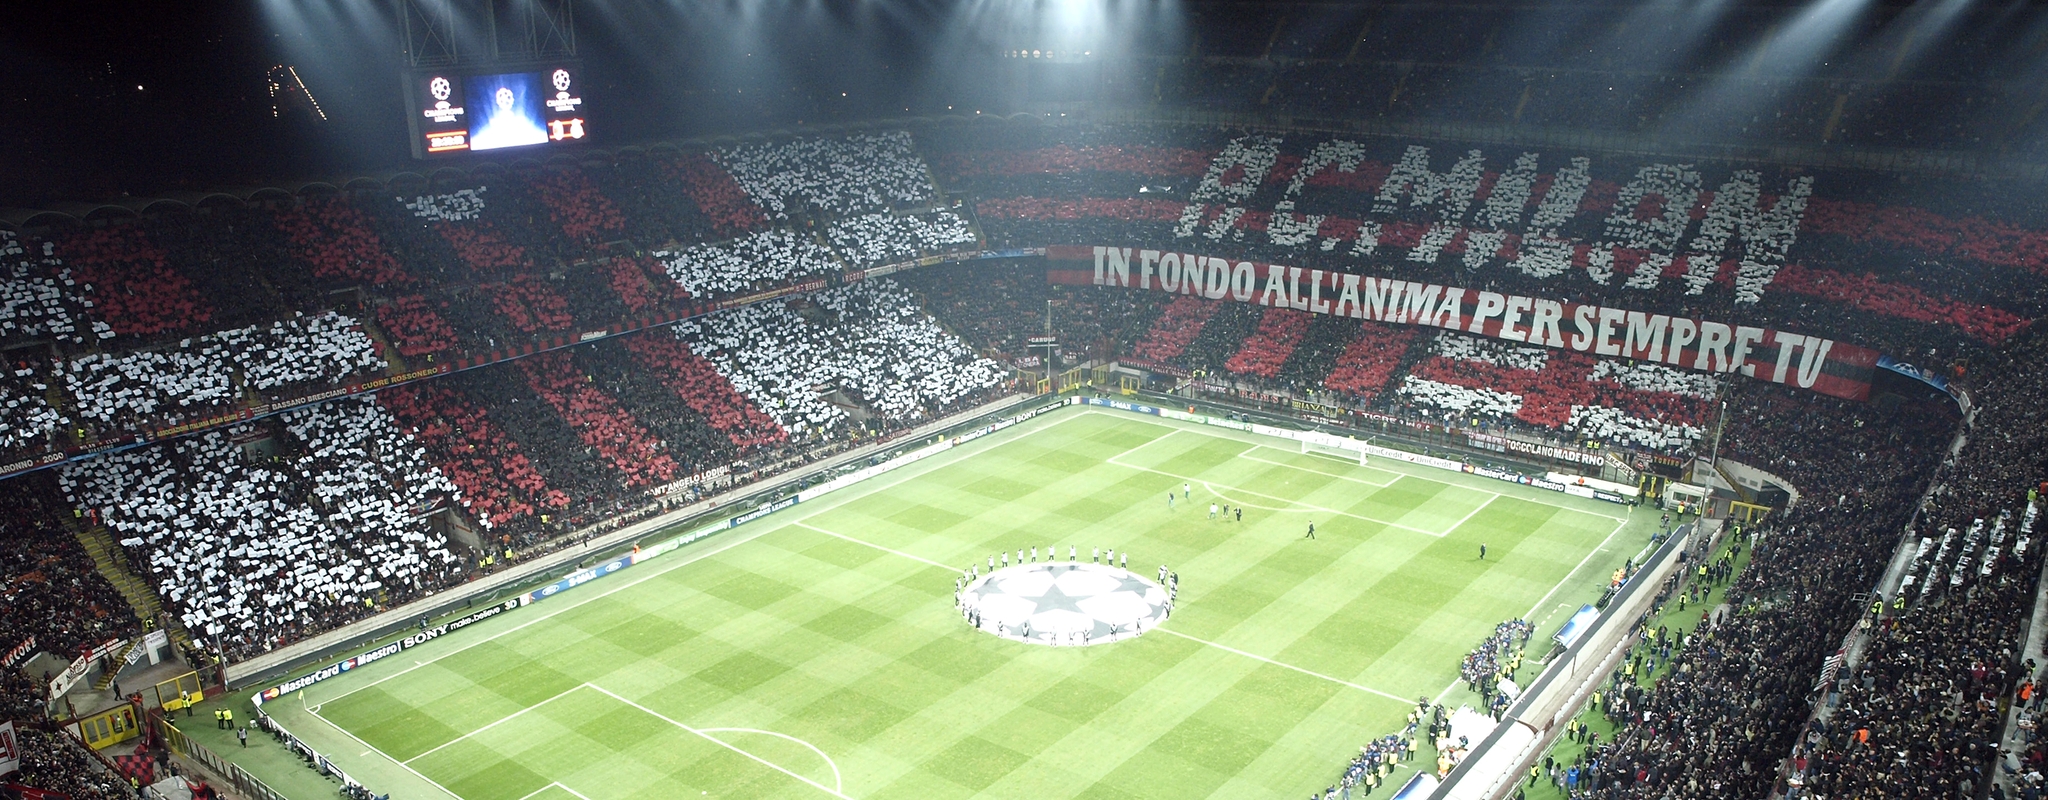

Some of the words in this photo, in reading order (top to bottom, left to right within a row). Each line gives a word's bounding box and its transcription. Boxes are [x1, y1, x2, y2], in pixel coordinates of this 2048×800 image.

[1349, 144, 1815, 305] MILAN
[805, 280, 828, 291] BERNATE
[1093, 246, 1132, 288] IN
[1140, 249, 1256, 302] FONDO
[1259, 265, 1466, 331] ALL'ANIMA
[1468, 290, 1564, 348] PER
[1571, 304, 1765, 378] SEMPRE
[1773, 331, 1834, 389] TU
[361, 378, 389, 391] CUORE
[391, 367, 438, 384] ROSSONERO
[272, 397, 306, 411] BASSANO
[307, 388, 347, 403] BRESCIANO
[1016, 409, 1037, 423] SONY
[1207, 416, 1244, 430] Heineken
[43, 452, 64, 464] 2000
[1474, 466, 1518, 482] MasterCard
[1531, 478, 1564, 492] Maestro
[736, 507, 772, 525] CHAMPIONS
[772, 499, 794, 512] LEAGUE
[568, 570, 597, 587] S-MAX
[404, 624, 449, 649] SONY
[504, 600, 518, 611] 3D
[280, 665, 339, 695] MasterCard
[357, 645, 397, 666] Maestro
